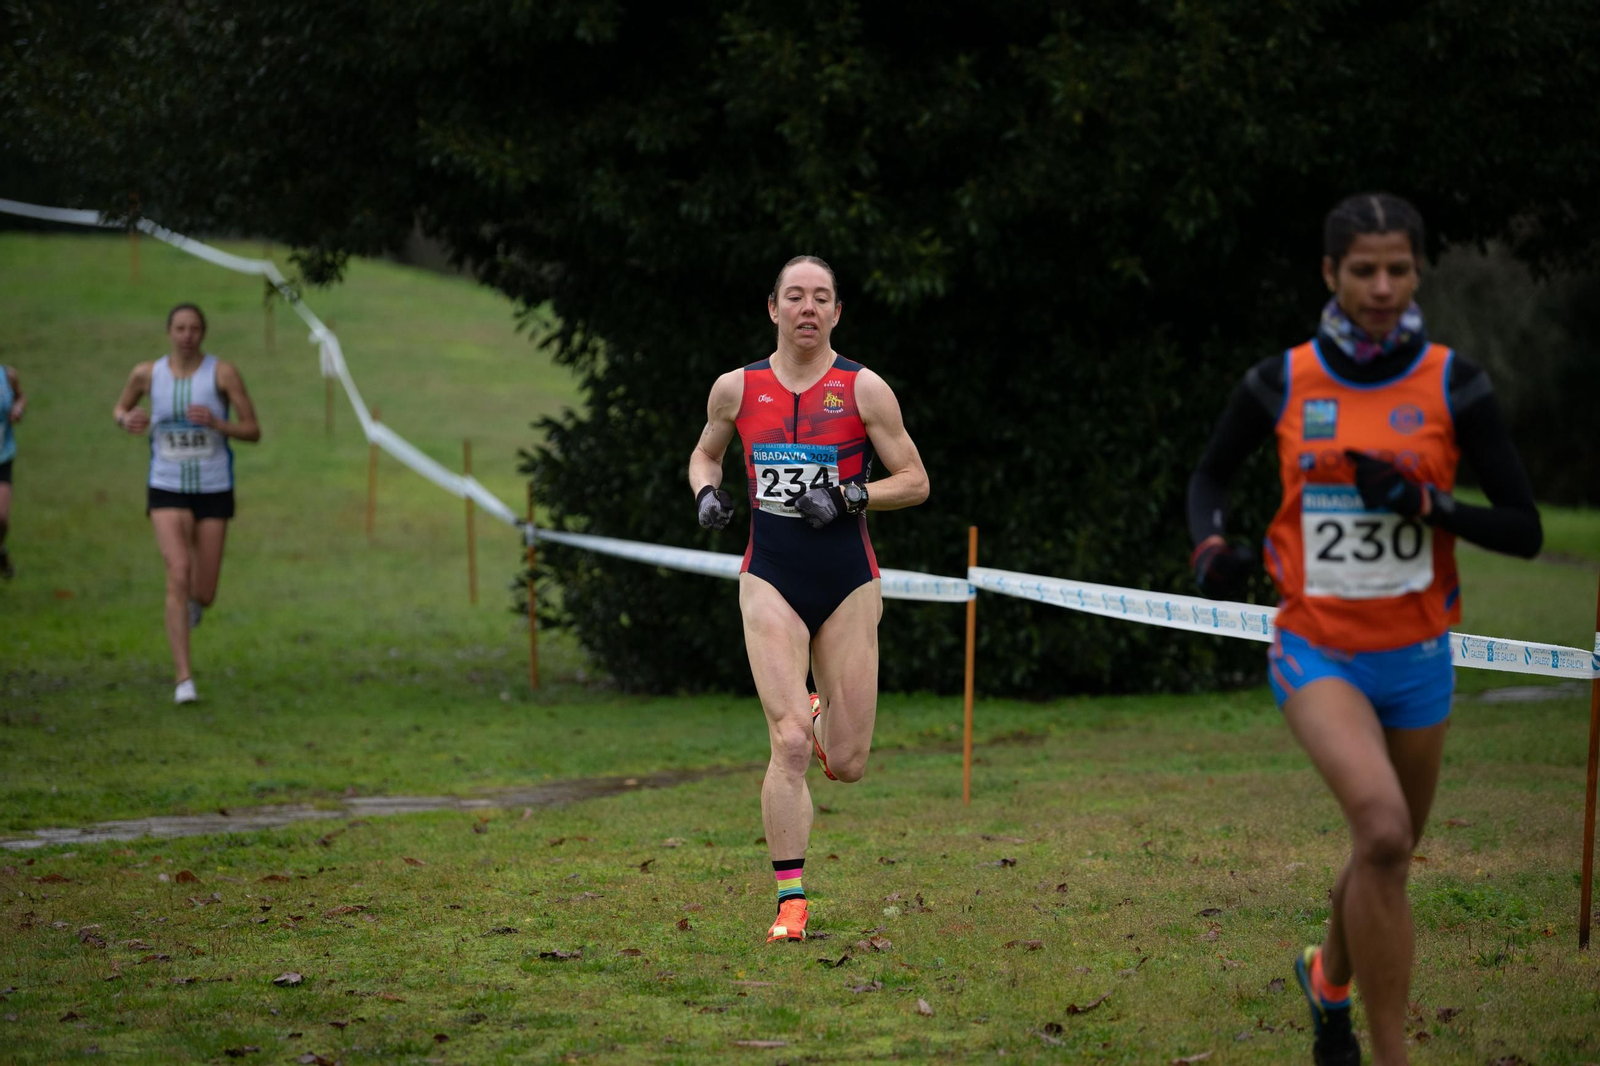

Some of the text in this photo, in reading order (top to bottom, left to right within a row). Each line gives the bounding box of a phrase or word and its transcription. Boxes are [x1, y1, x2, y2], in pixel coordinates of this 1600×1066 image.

[753, 451, 835, 463] RIBADAVIA 2026
[762, 467, 833, 497] 234
[1316, 520, 1423, 562] 230
[1470, 650, 1485, 659] GALEGO
[1501, 652, 1517, 662] GALICIA
[1535, 656, 1550, 666] GALEGO
[1567, 659, 1583, 669] GALICIA
